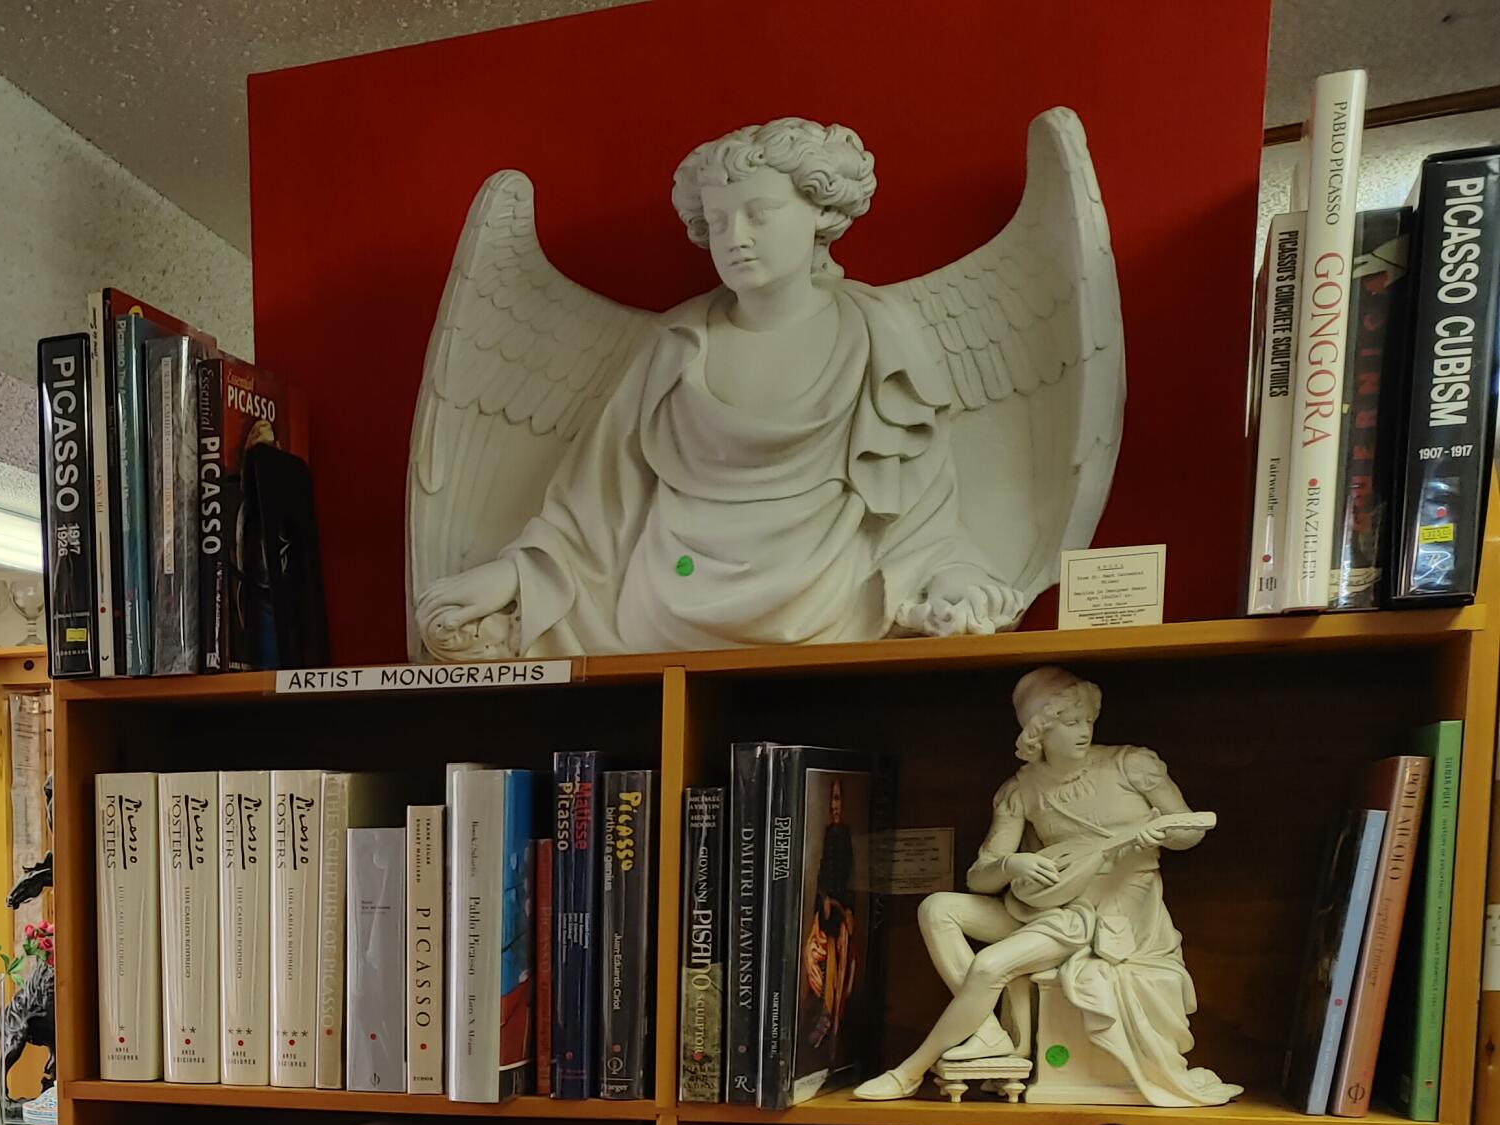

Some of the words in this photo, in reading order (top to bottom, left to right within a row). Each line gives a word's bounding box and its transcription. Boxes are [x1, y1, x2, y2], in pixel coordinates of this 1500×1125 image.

[1330, 101, 1348, 153] PABLO
[1325, 157, 1345, 226] PICASSO
[1276, 229, 1300, 283] PICASSO'S
[1438, 177, 1485, 304] PICASSO
[1273, 284, 1297, 335] CONCRETE
[1268, 336, 1293, 399] SCULPTURES
[1301, 252, 1345, 450] GONGORA
[1430, 316, 1472, 428] CUBISM
[200, 367, 216, 432] Essential
[227, 388, 277, 423] PICASSO
[52, 356, 80, 513] PICASSO
[1418, 444, 1473, 460] 1907-1917
[201, 436, 222, 555] PICASSO
[56, 524, 70, 558] 1926
[69, 523, 81, 555] 1917
[1301, 486, 1322, 580] BRAZILLER
[288, 670, 363, 690] ARTIST
[381, 665, 545, 687] MONOGRAPHS
[106, 794, 117, 869] POSTERS
[125, 796, 143, 865] Picasso
[171, 794, 182, 869] POSTERS
[191, 796, 209, 865] Picasso
[224, 794, 236, 869] POSTERS
[243, 796, 262, 865] Picasso
[275, 794, 287, 869] POSTERS
[296, 796, 315, 865] Picasso
[557, 782, 573, 851] Picasso
[574, 782, 593, 851] Matisse
[772, 816, 793, 881] PLETKA
[323, 829, 338, 928] SCULPTURE
[698, 847, 709, 903] GIOVANNI
[740, 827, 756, 898] DMITRI
[322, 930, 336, 953] OF
[415, 906, 432, 1028] PICASSO
[738, 905, 755, 1011] PLAVINSKY
[320, 959, 336, 1028] PICASSO
[694, 993, 705, 1054] SCULPTOR
